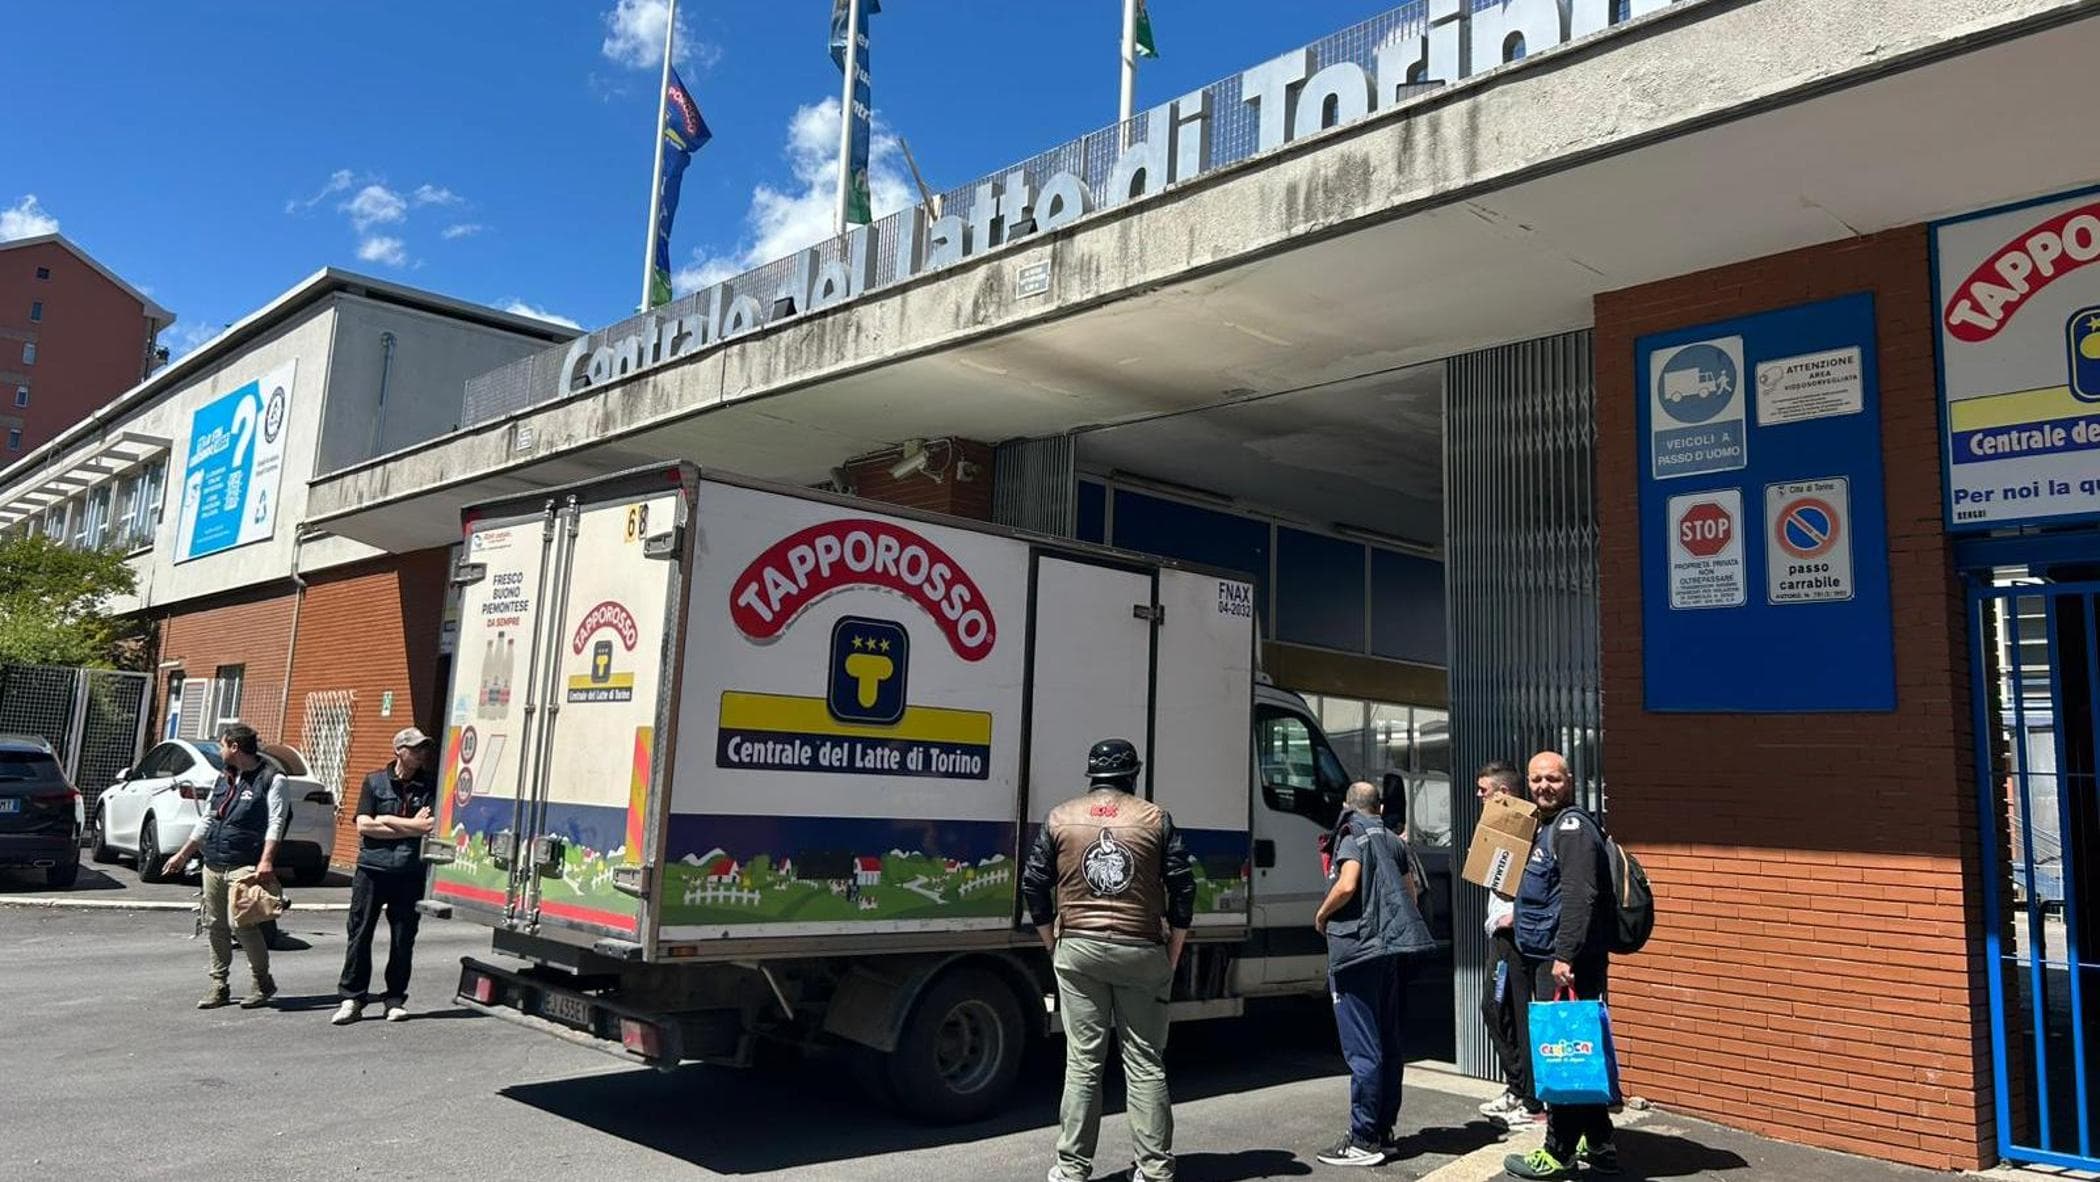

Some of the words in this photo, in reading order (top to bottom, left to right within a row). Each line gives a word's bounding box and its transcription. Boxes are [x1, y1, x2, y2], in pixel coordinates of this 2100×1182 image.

[1105, 90, 1203, 208] di
[1786, 356, 1854, 374] ATTENZIONE
[1666, 434, 1715, 450] VEICOLI
[1722, 432, 1730, 442] A
[1969, 424, 2067, 455] Centrale
[1657, 451, 1693, 465] PASSO
[1954, 487, 1995, 505] Per
[2003, 481, 2040, 500] noi
[2049, 479, 2071, 496] la
[1681, 518, 1729, 541] STOP
[493, 571, 523, 586] FRESCO
[1789, 563, 1829, 576] passo
[737, 531, 988, 648] TAPPOROSSO
[1219, 582, 1250, 603] FNAX
[1780, 576, 1840, 590] carrabile
[493, 586, 520, 600] BUONO
[482, 600, 529, 614] PIEMONTESE
[574, 605, 637, 648] TAPPOROSSO
[727, 735, 812, 766] Centrale
[818, 742, 849, 767] del
[855, 743, 900, 770] Latte
[906, 747, 924, 771] di
[930, 748, 982, 775] Torino
